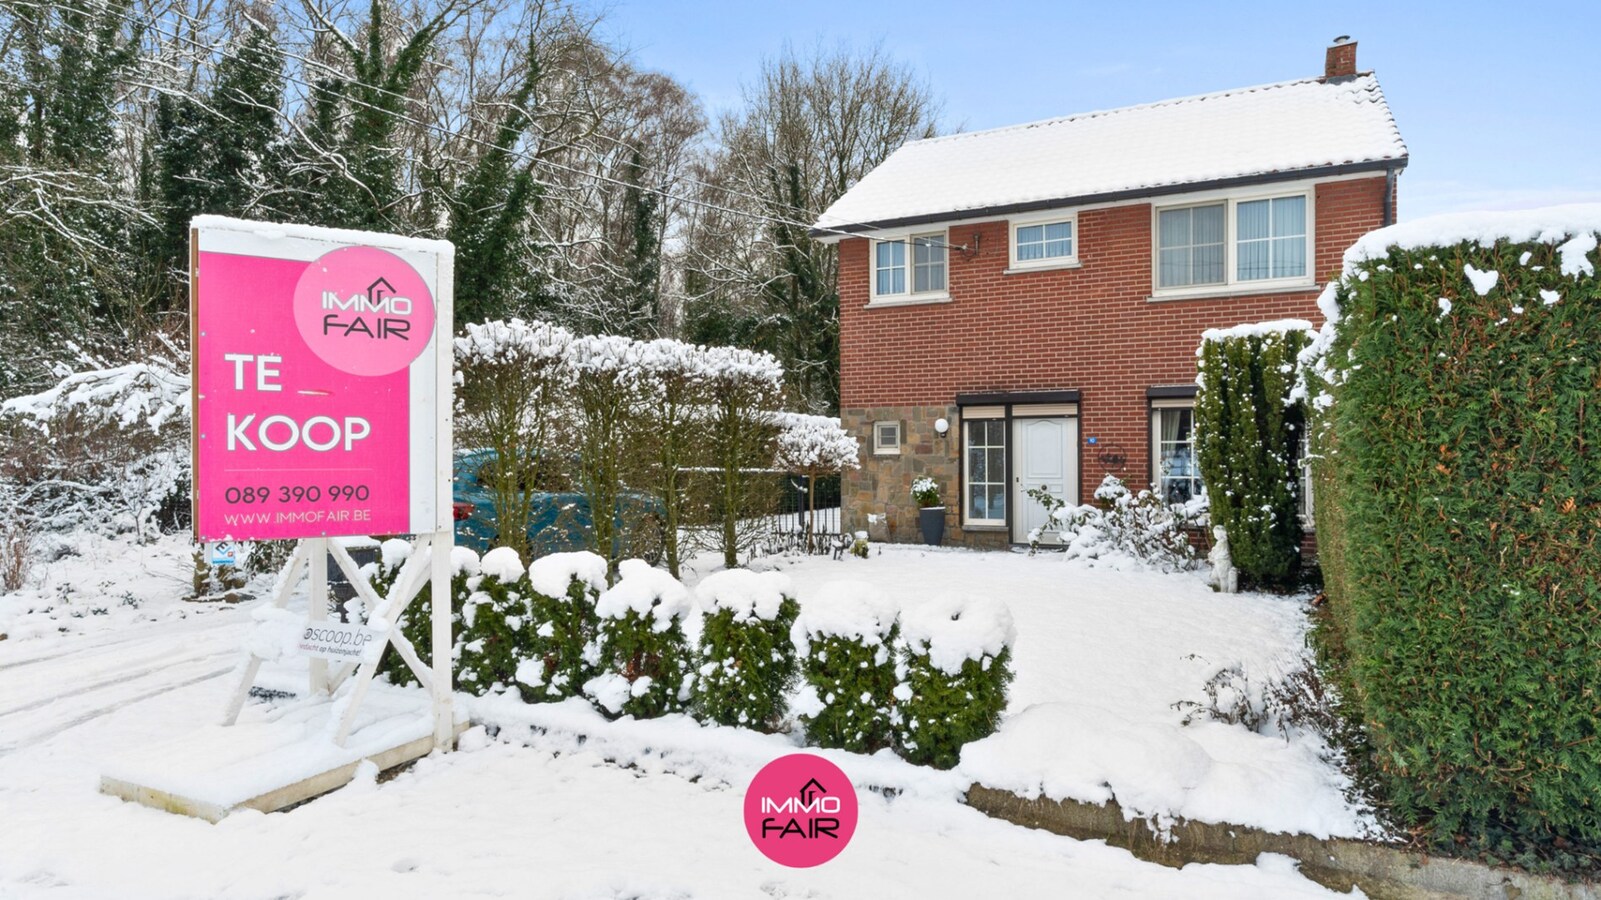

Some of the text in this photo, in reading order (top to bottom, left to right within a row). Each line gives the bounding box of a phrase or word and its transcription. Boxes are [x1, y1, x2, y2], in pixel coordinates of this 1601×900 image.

[323, 291, 412, 315] IMMO
[323, 314, 411, 341] FAIR
[224, 354, 282, 391] TE
[227, 414, 371, 451] KOOP
[225, 484, 370, 504] 089 390 990
[224, 509, 371, 525] WWW.IMMOFAIR.BE
[303, 628, 372, 647] oscoop.be
